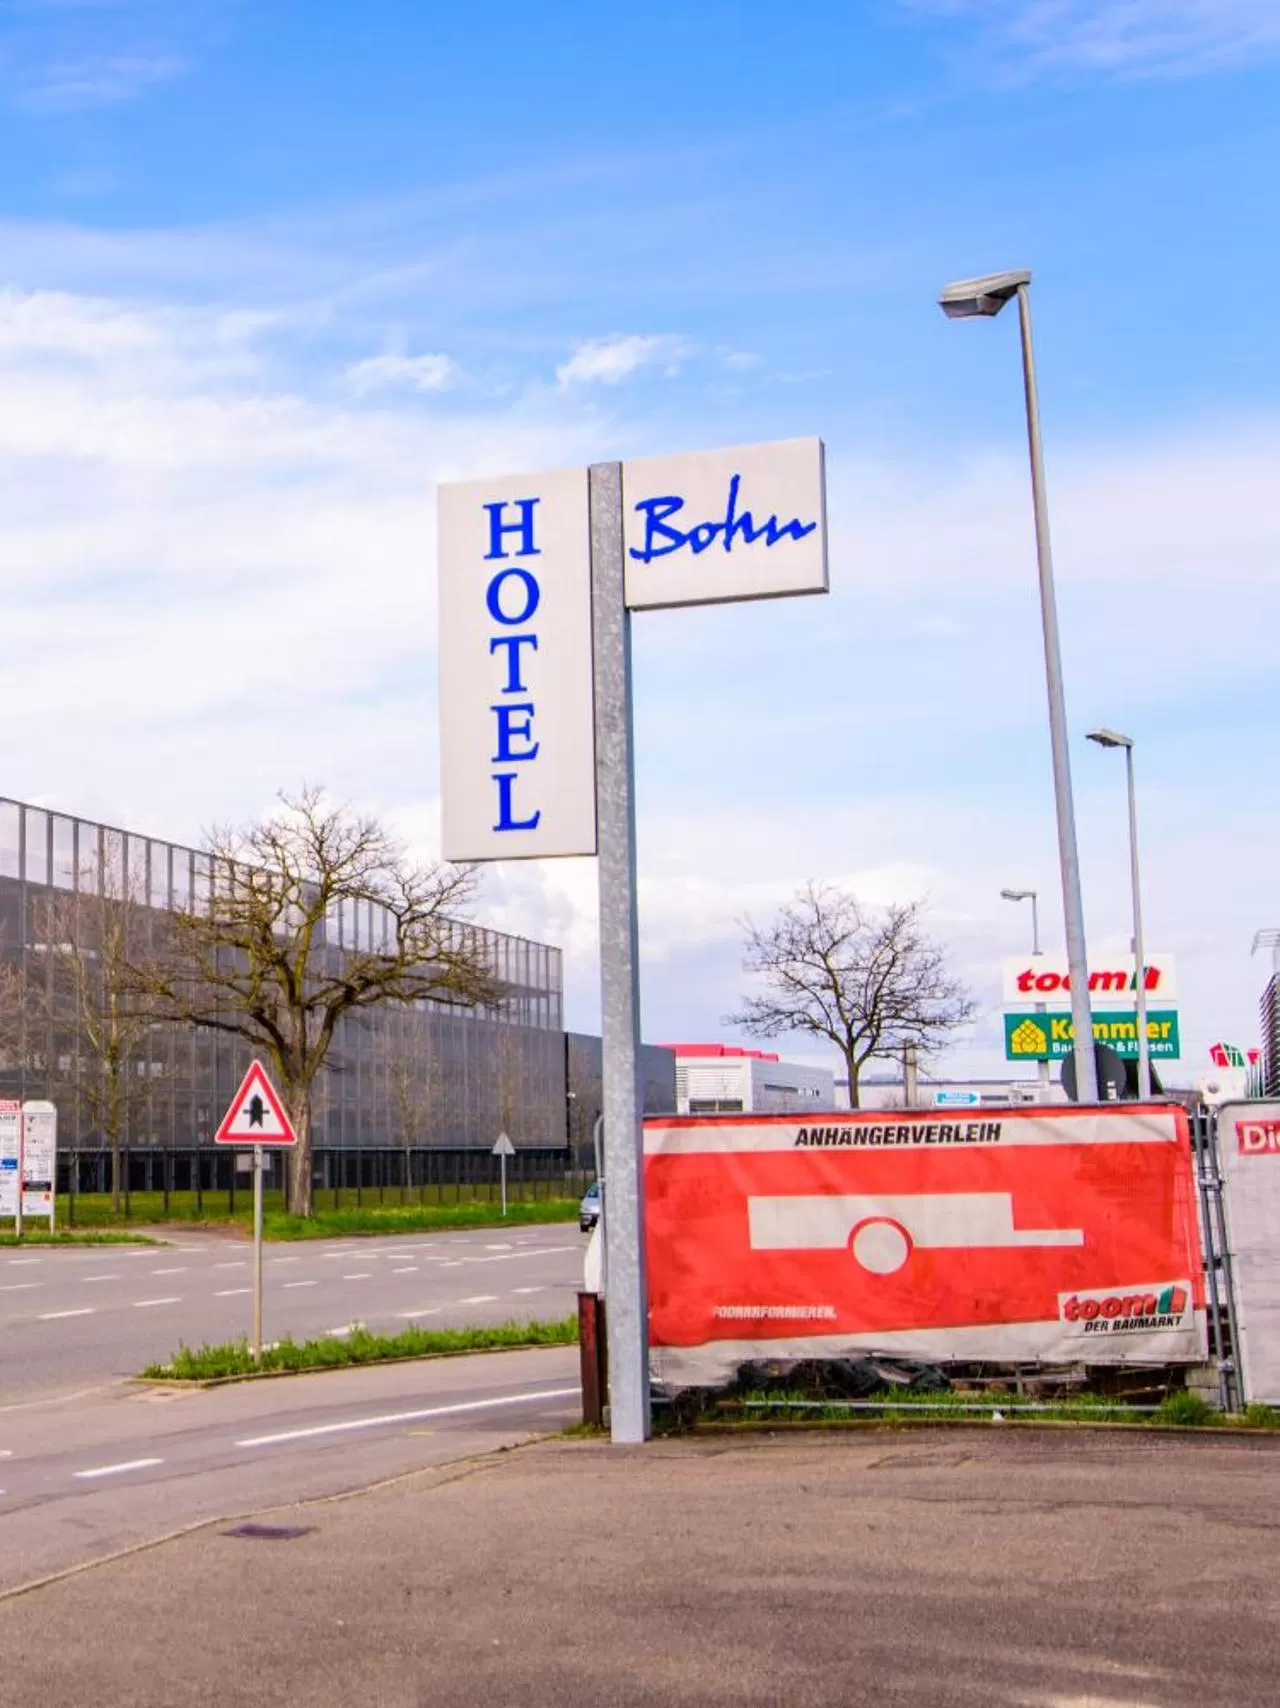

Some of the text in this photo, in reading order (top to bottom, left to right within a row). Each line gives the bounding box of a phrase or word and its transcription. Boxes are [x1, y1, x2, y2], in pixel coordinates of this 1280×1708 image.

[628, 473, 817, 564] Bohn
[482, 497, 541, 832] HOTEL
[794, 1122, 1002, 1146] ANHÄNGERVERLEIH
[1243, 1125, 1280, 1149] Di
[1064, 1293, 1158, 1321] toom
[1084, 1315, 1183, 1332] DER BAUMARKT
